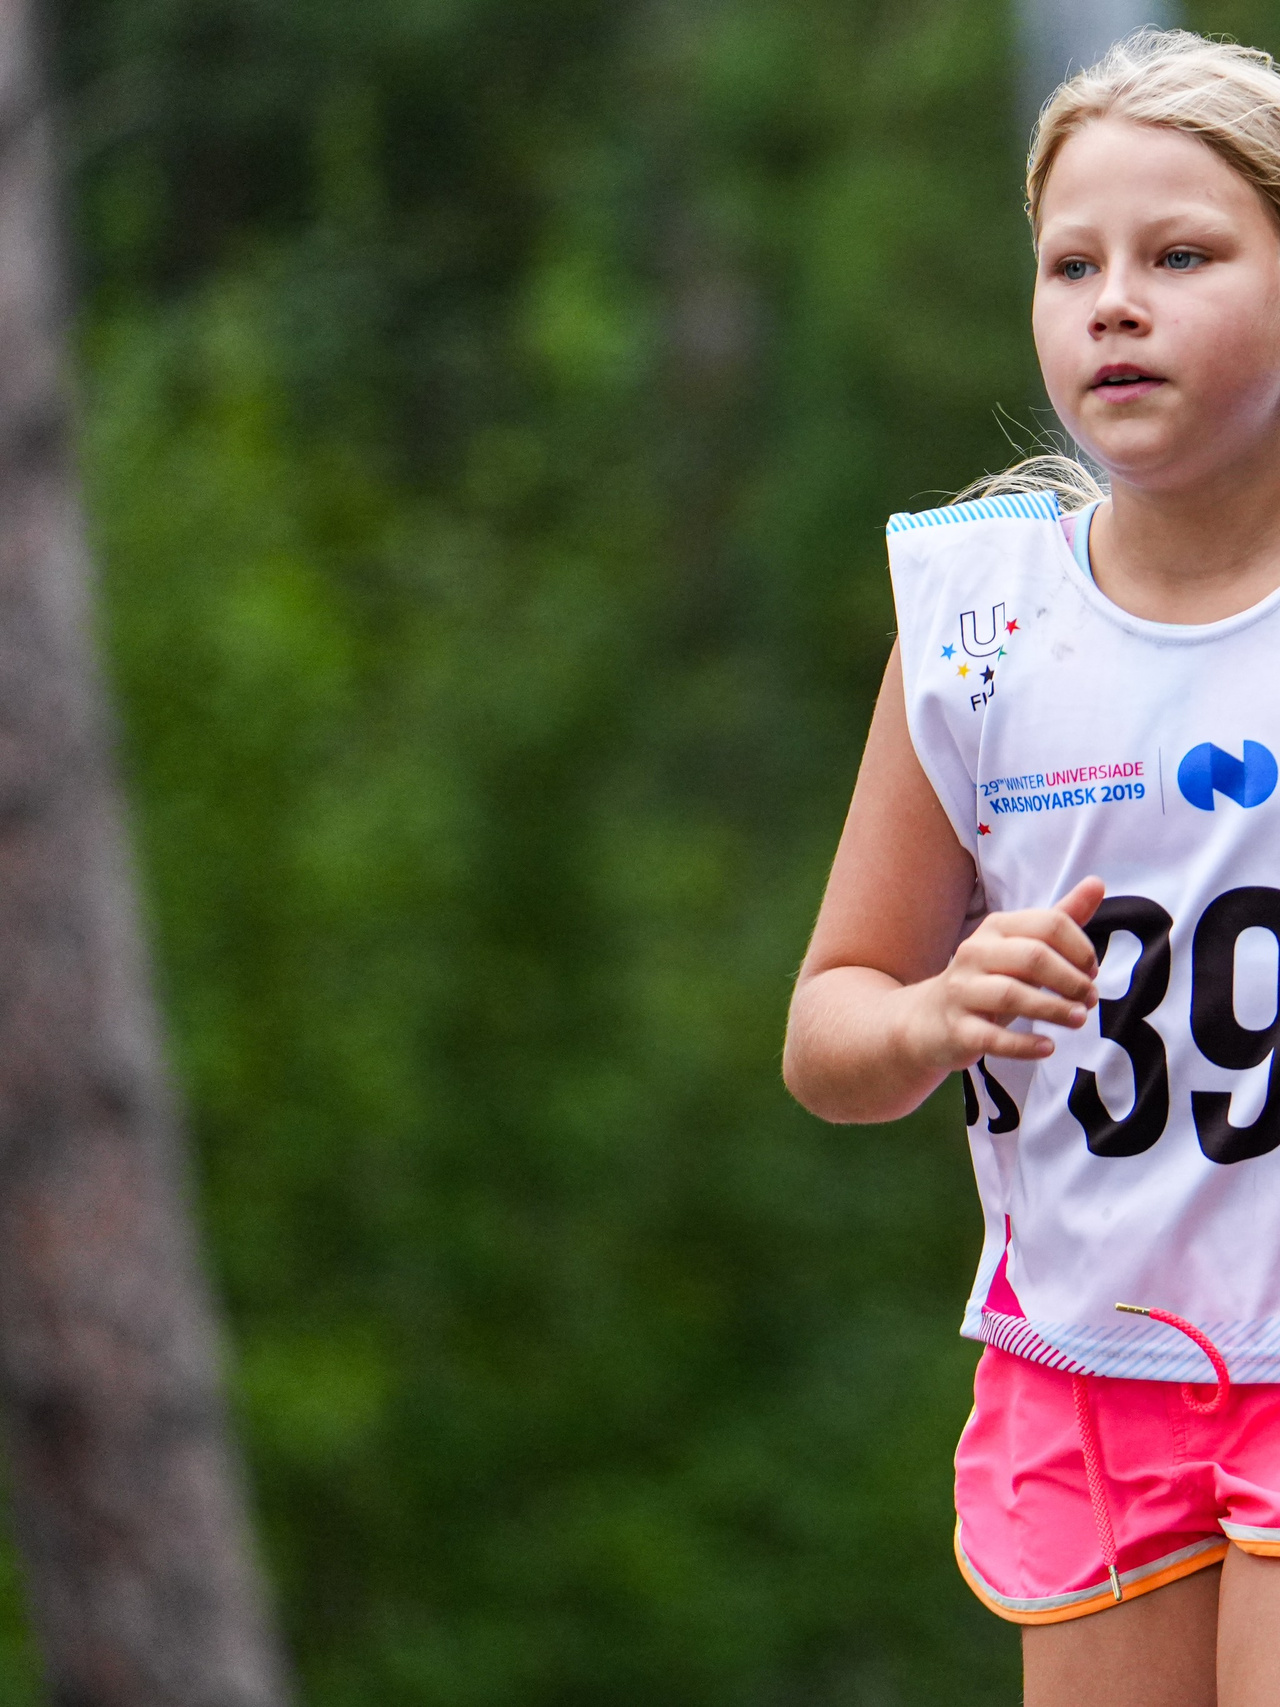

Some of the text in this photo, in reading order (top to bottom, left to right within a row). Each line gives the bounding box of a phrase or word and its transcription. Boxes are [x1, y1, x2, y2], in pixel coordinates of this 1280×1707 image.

[1004, 773, 1045, 791] WINTER
[1046, 761, 1144, 787] UNIVERSIADE
[989, 782, 1146, 815] KRASNOYARSK 2019
